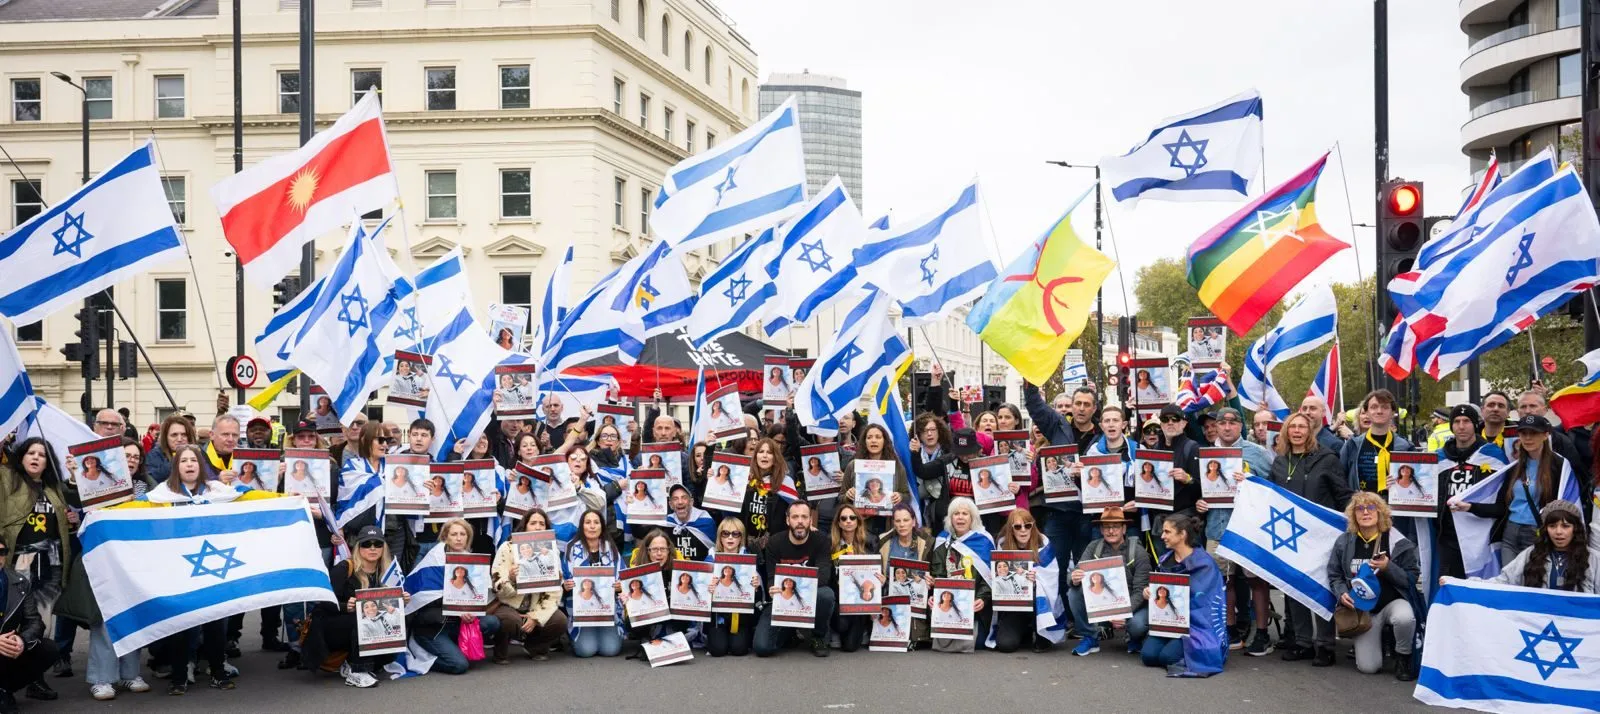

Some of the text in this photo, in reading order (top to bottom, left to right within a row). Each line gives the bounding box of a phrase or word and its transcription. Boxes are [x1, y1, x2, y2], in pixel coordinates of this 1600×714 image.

[687, 351, 744, 366] HATE
[237, 364, 254, 378] 20
[677, 536, 691, 547] LET
